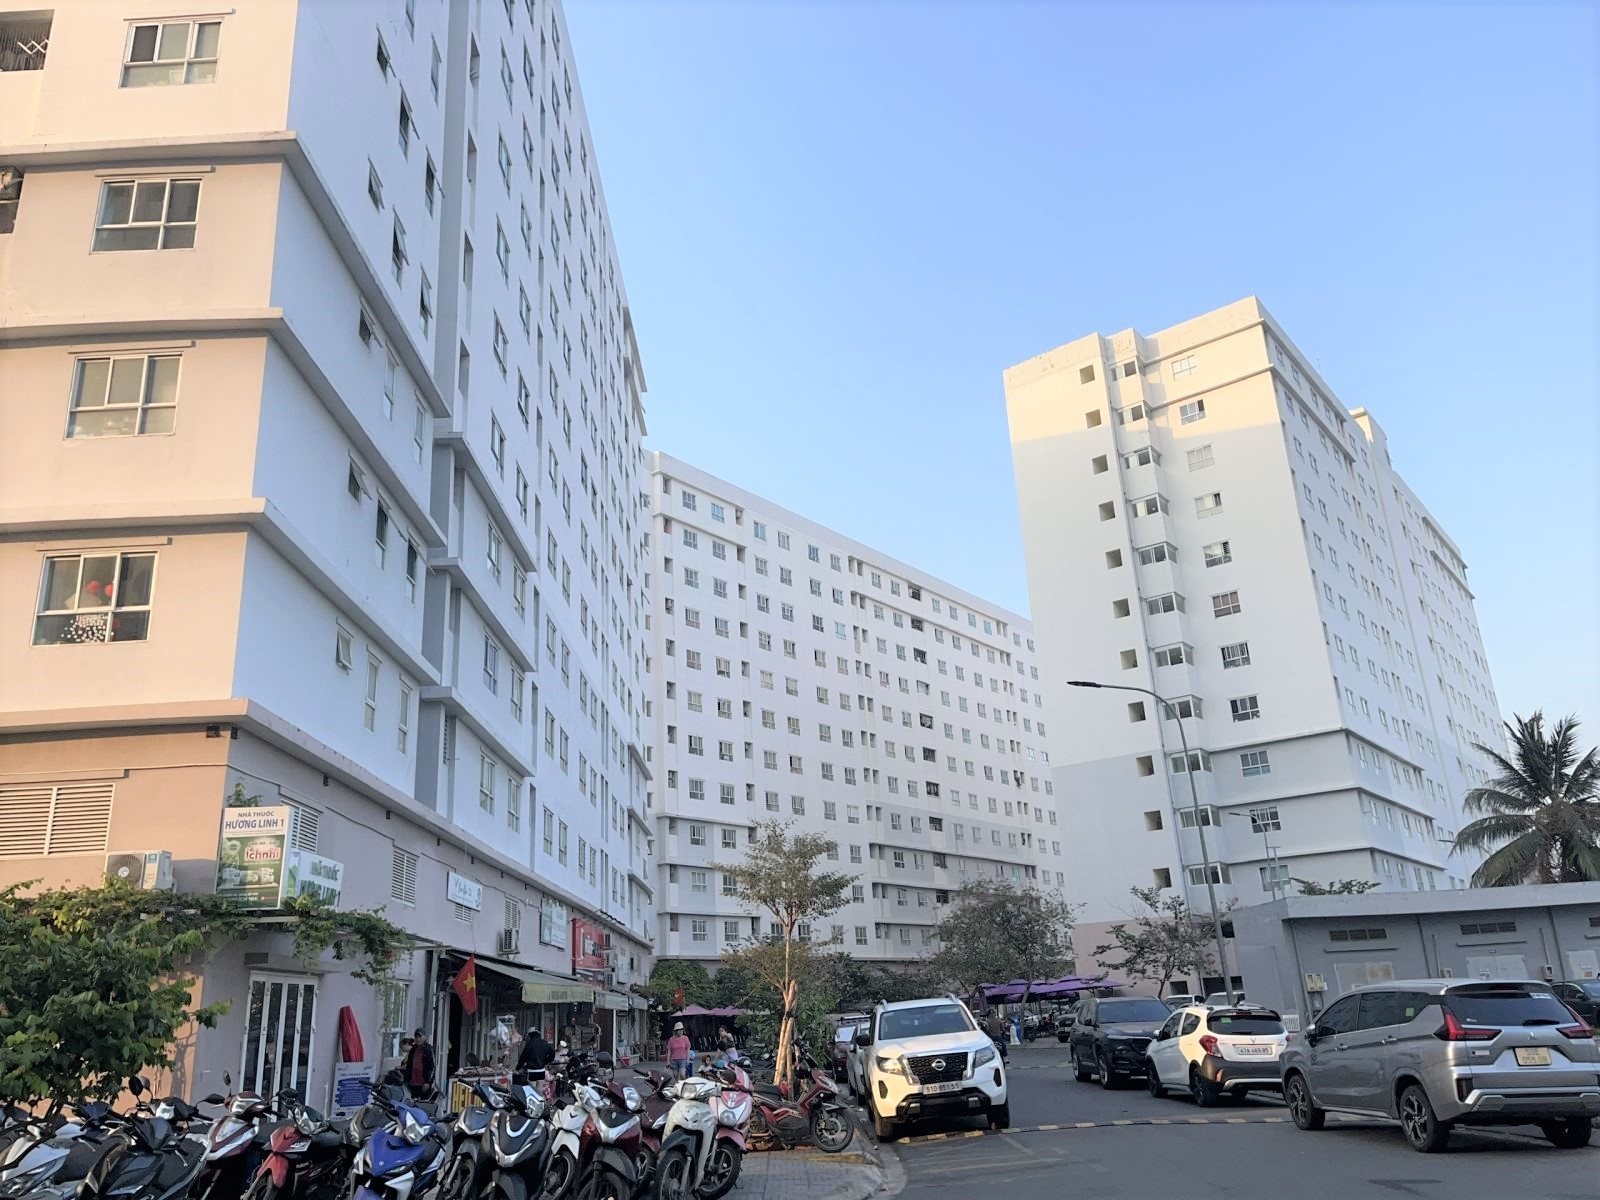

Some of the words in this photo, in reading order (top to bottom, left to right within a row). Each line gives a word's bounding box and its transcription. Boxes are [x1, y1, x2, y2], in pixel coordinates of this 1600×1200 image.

[225, 819, 257, 829] HƯƠNG
[259, 818, 278, 828] LINH
[281, 818, 284, 827] 1
